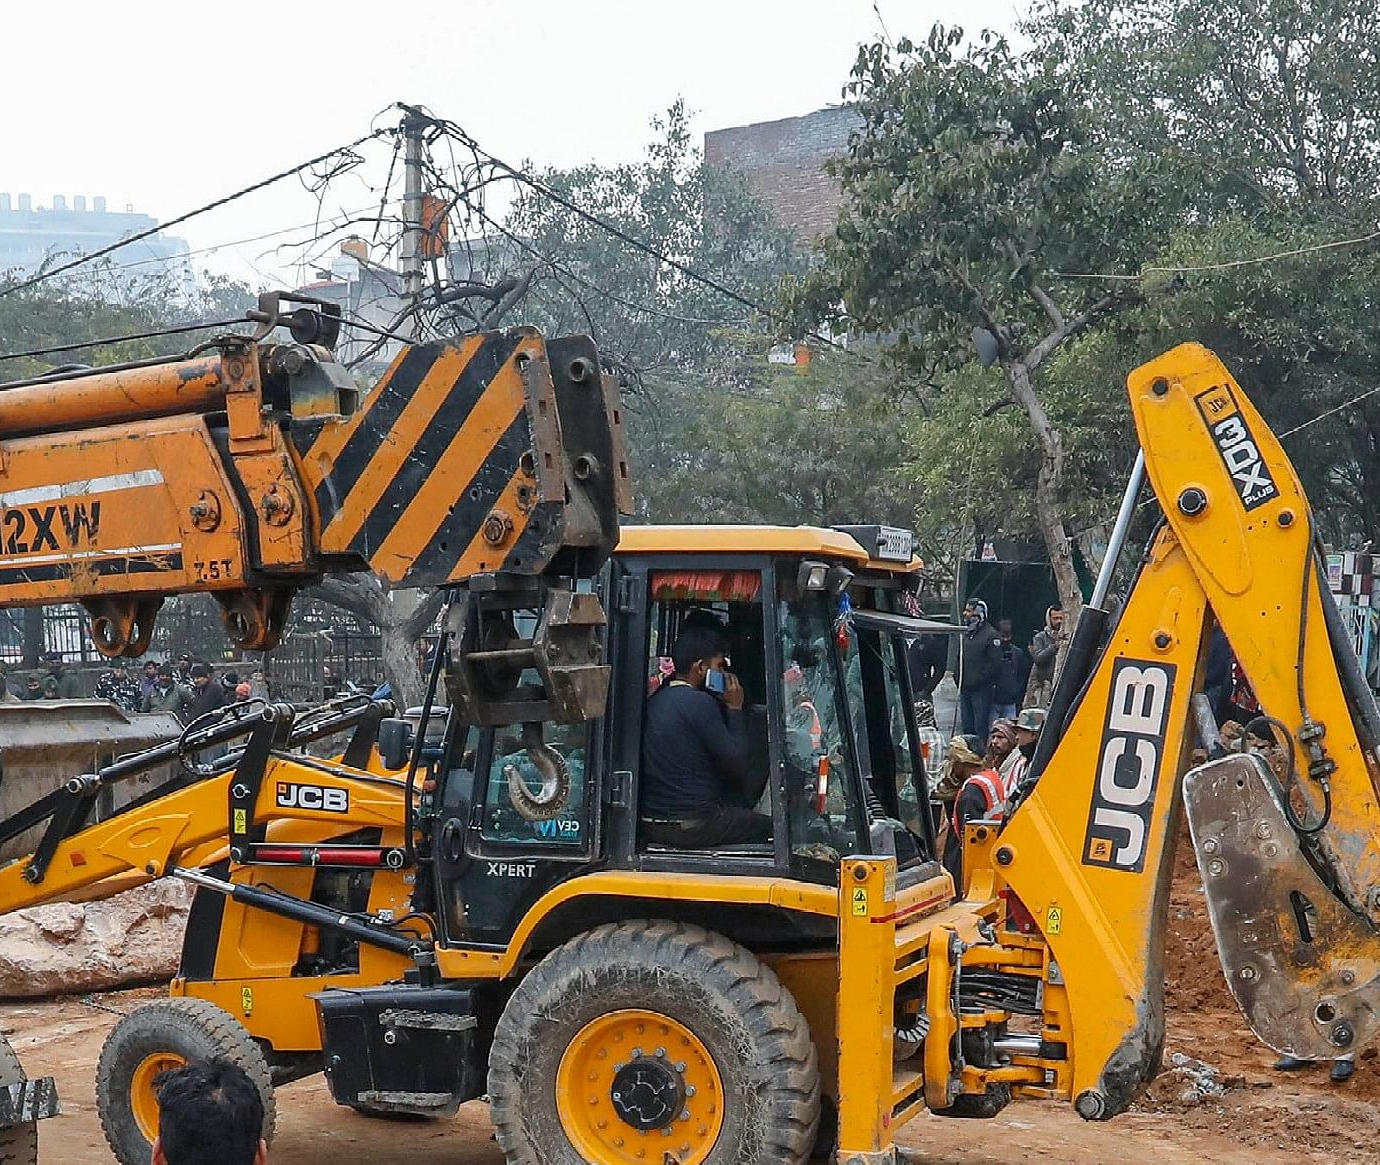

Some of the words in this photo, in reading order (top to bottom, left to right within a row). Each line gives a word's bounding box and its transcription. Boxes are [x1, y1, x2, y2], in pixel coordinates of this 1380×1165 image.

[1214, 416, 1272, 498] 3DX
[1244, 485, 1275, 505] PLUS
[193, 558, 233, 582] 7.5T
[1093, 666, 1168, 866] JCB
[277, 784, 348, 812] JCB
[486, 862, 536, 878] XPERT
